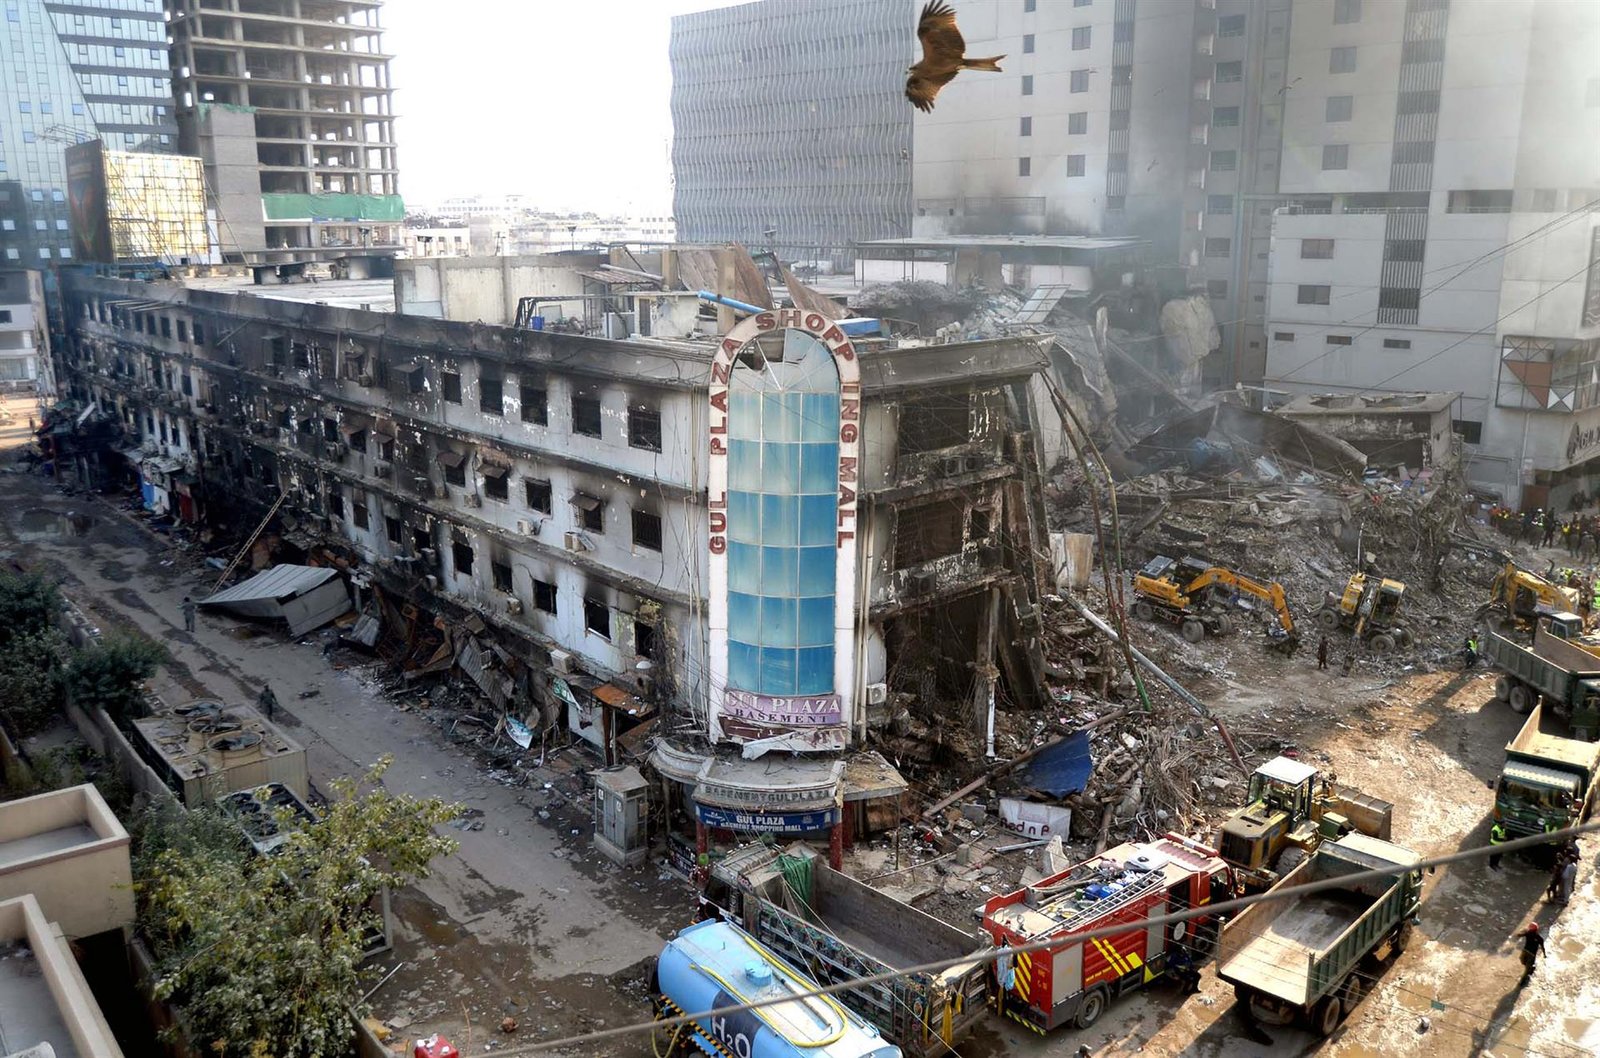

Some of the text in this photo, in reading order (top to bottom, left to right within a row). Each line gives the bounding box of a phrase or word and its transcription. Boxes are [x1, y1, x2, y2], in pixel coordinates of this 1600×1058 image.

[709, 310, 861, 554] GUL PLAZA SHOPPING MALL
[771, 698, 841, 714] PLAZA
[735, 708, 828, 723] BASEMENT
[736, 815, 754, 825] GUL
[756, 816, 785, 826] PLAZA
